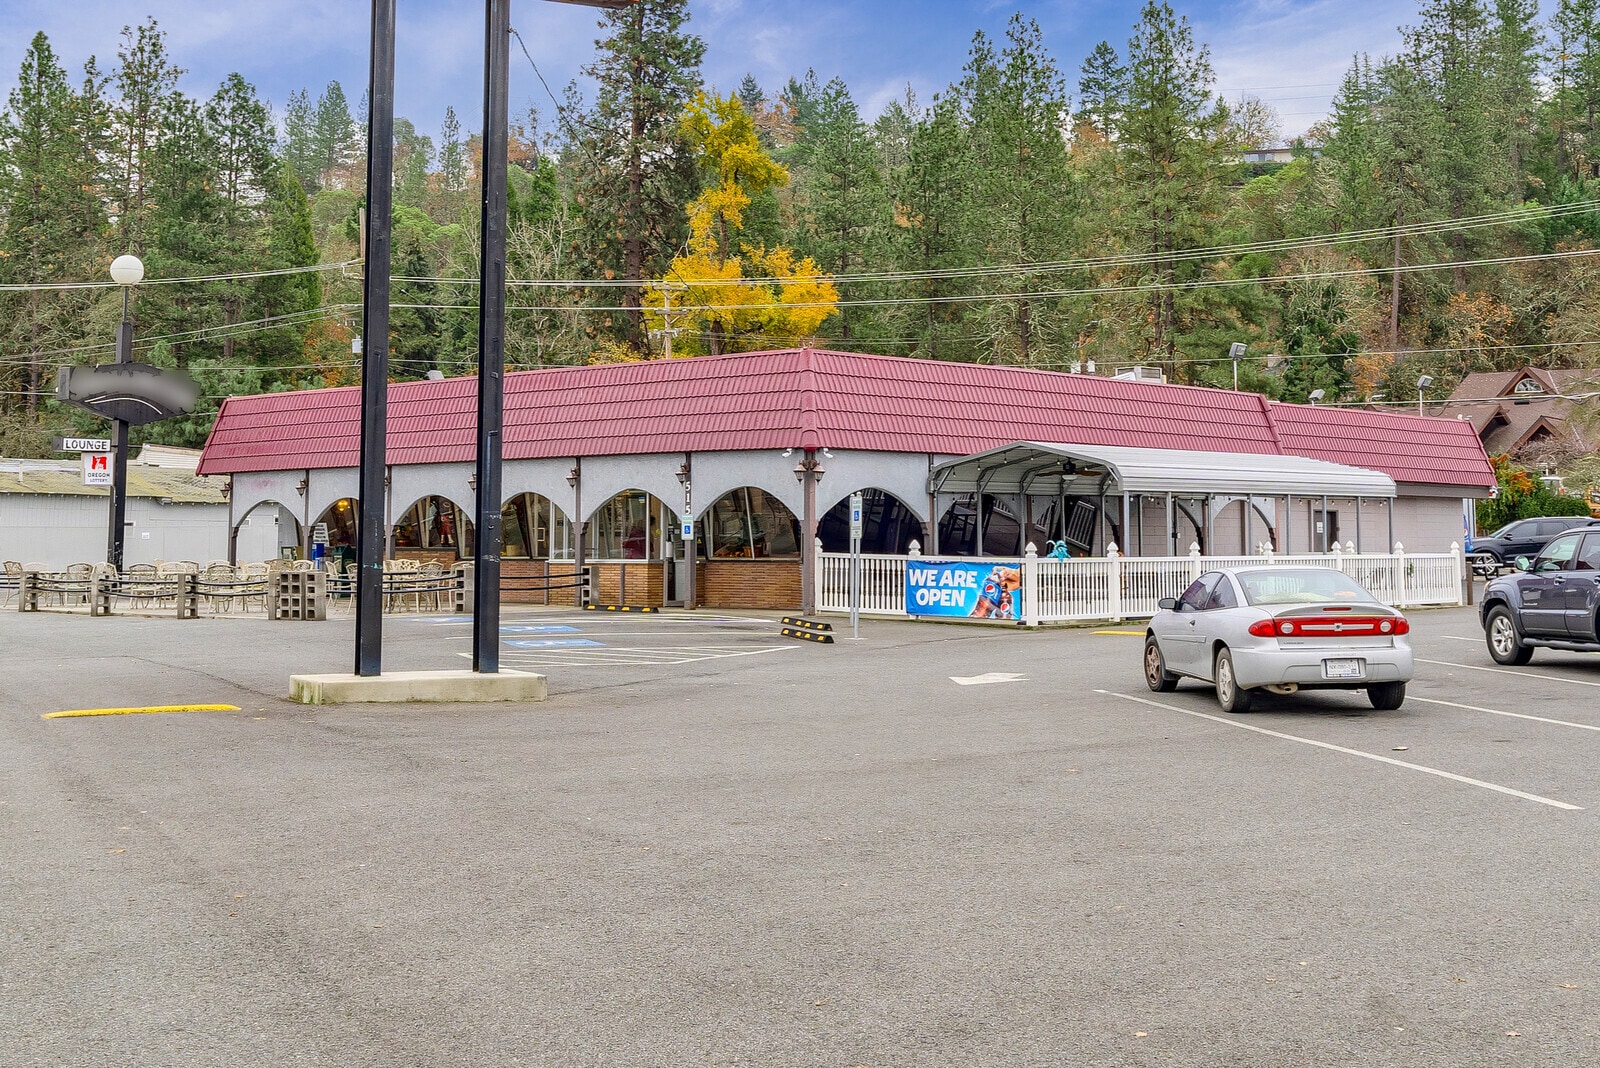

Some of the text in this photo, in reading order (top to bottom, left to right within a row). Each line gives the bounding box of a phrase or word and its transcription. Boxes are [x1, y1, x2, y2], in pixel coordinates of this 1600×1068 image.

[65, 439, 108, 450] LOUNGE
[909, 569, 978, 588] WE ARE
[915, 588, 966, 607] OPEN
